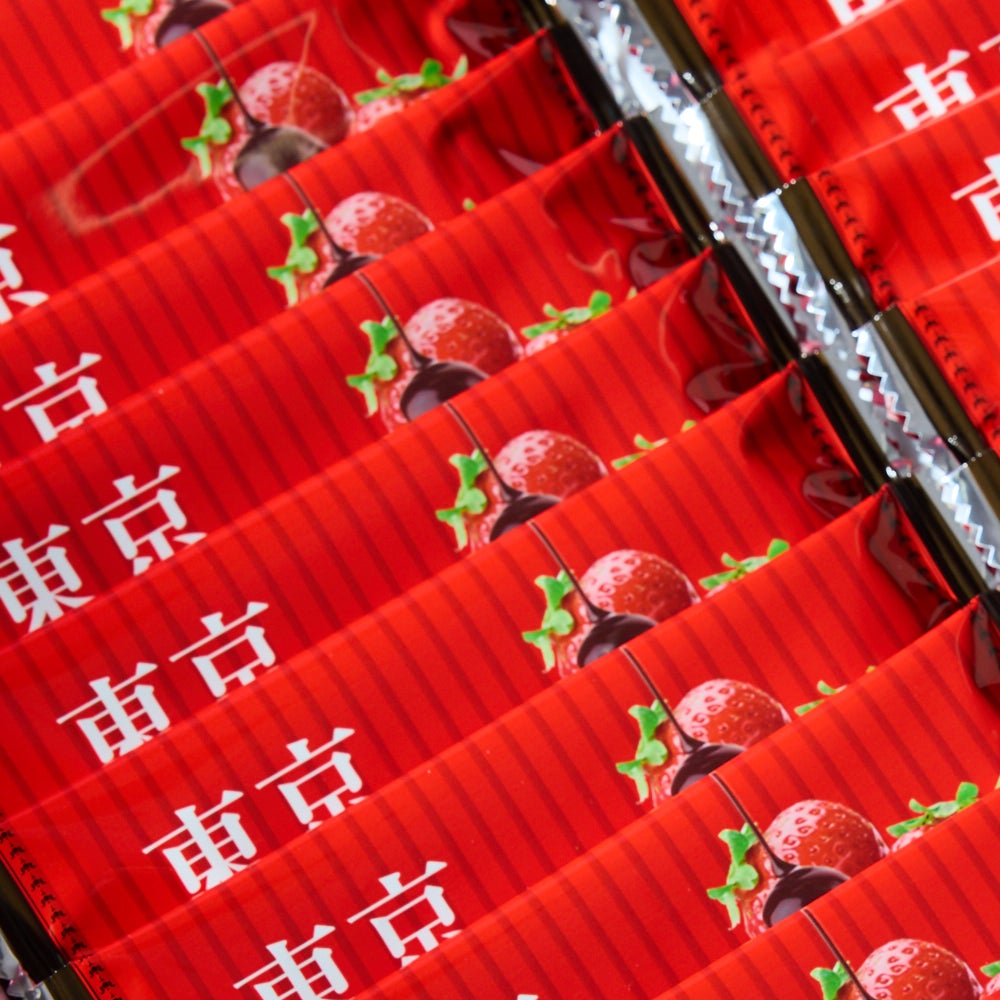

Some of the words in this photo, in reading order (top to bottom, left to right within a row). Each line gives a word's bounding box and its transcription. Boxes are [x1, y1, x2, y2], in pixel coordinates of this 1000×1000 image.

[0, 465, 207, 633] 東京
[56, 602, 276, 764] 東京
[142, 727, 366, 895] 東京
